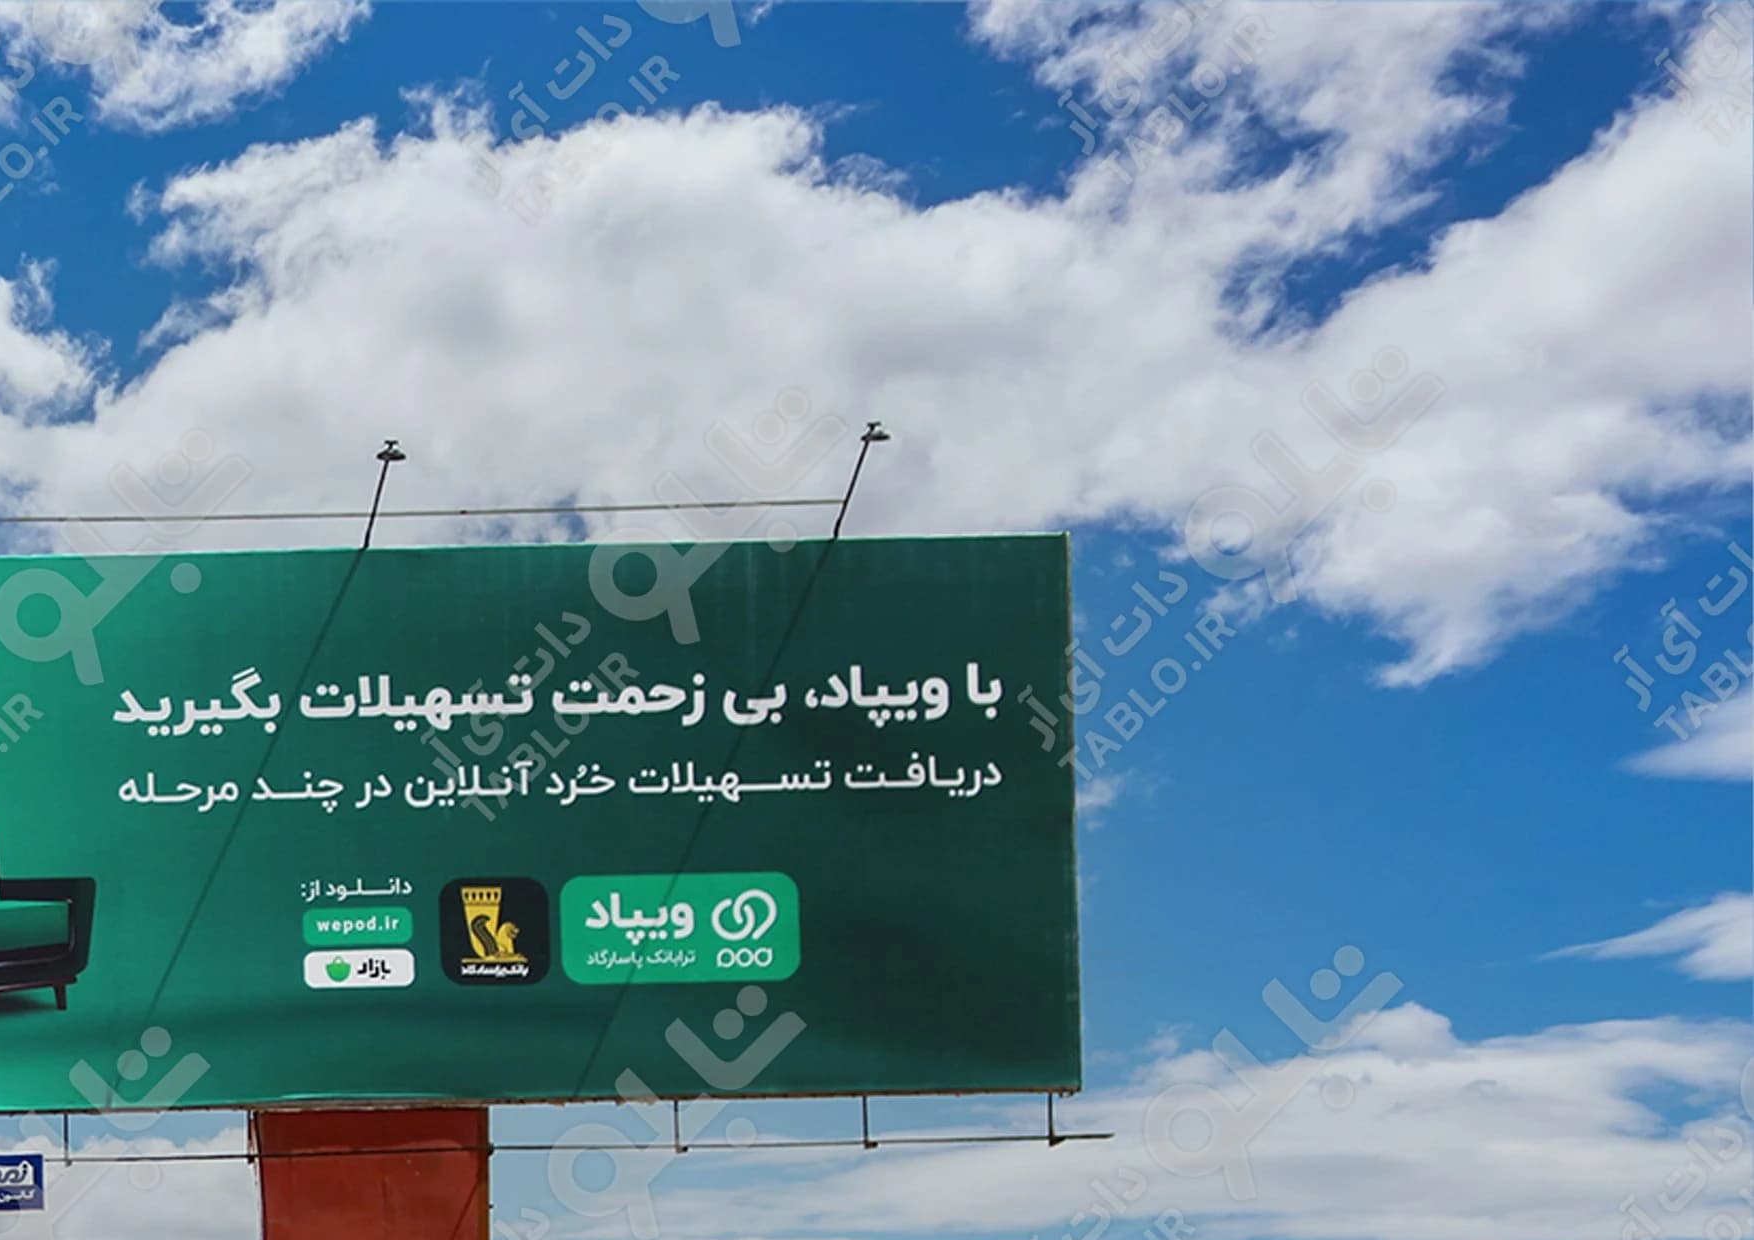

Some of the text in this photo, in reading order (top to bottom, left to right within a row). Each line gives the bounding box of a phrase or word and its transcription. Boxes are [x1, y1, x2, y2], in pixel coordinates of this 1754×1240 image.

[112, 662, 1003, 737] با ویپاد، بی زحمت تسهیلات بگیرید
[117, 772, 240, 812] مرحله
[251, 771, 345, 813] چند
[354, 774, 393, 809] در
[403, 760, 534, 807] آنلاین
[627, 759, 833, 802] تسهیلات
[843, 751, 1003, 798] دریافت
[326, 877, 413, 902] دانلود
[315, 915, 400, 935] wepod.ir
[584, 892, 695, 946] ویپاد
